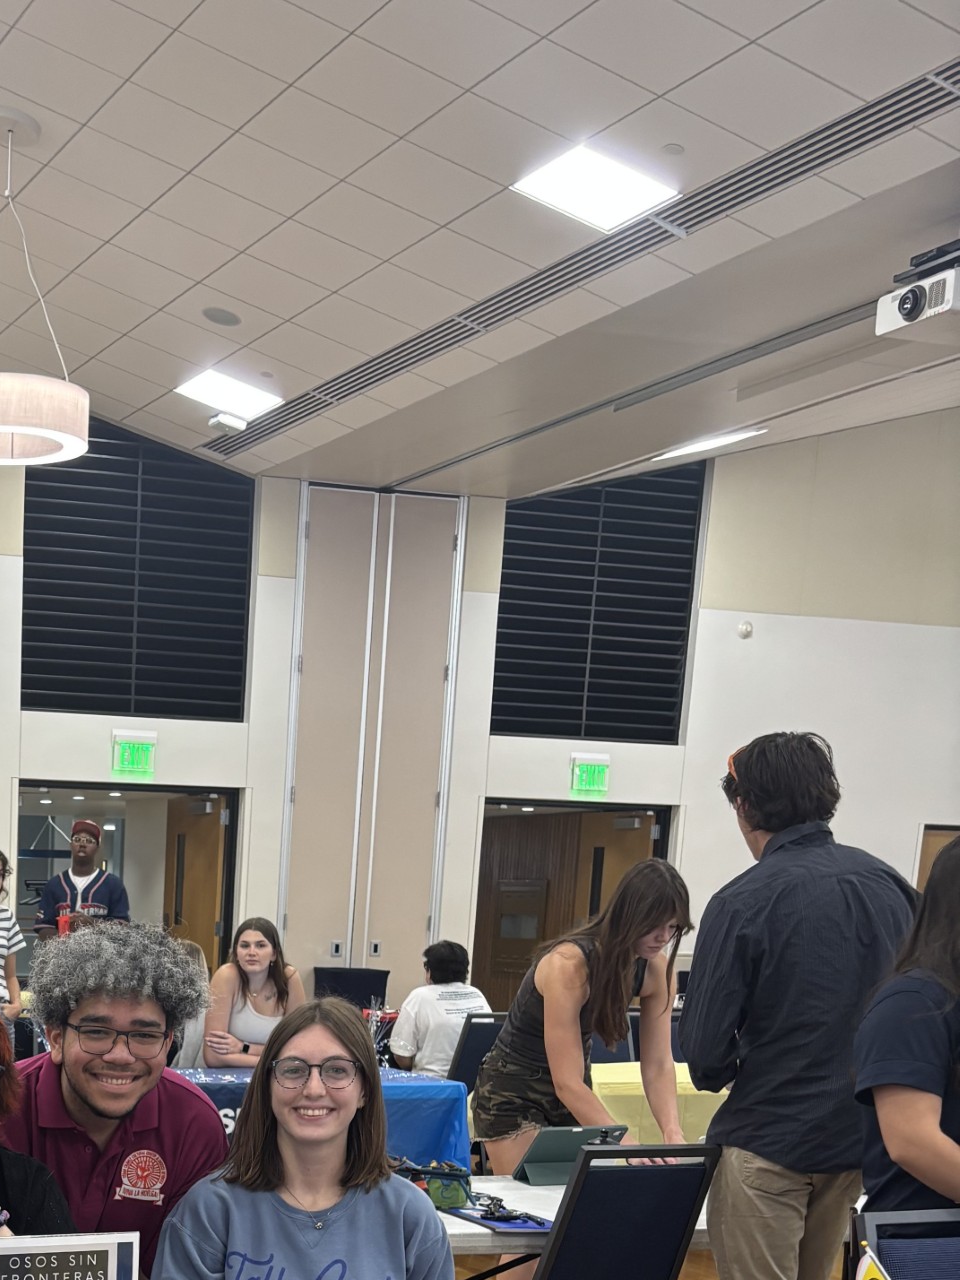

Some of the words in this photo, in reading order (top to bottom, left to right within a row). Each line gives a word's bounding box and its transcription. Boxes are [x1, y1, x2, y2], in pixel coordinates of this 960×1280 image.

[120, 743, 152, 769] EXIT
[579, 764, 606, 789] EXIT
[9, 1255, 58, 1269] OSOS
[68, 1253, 97, 1267] SIN
